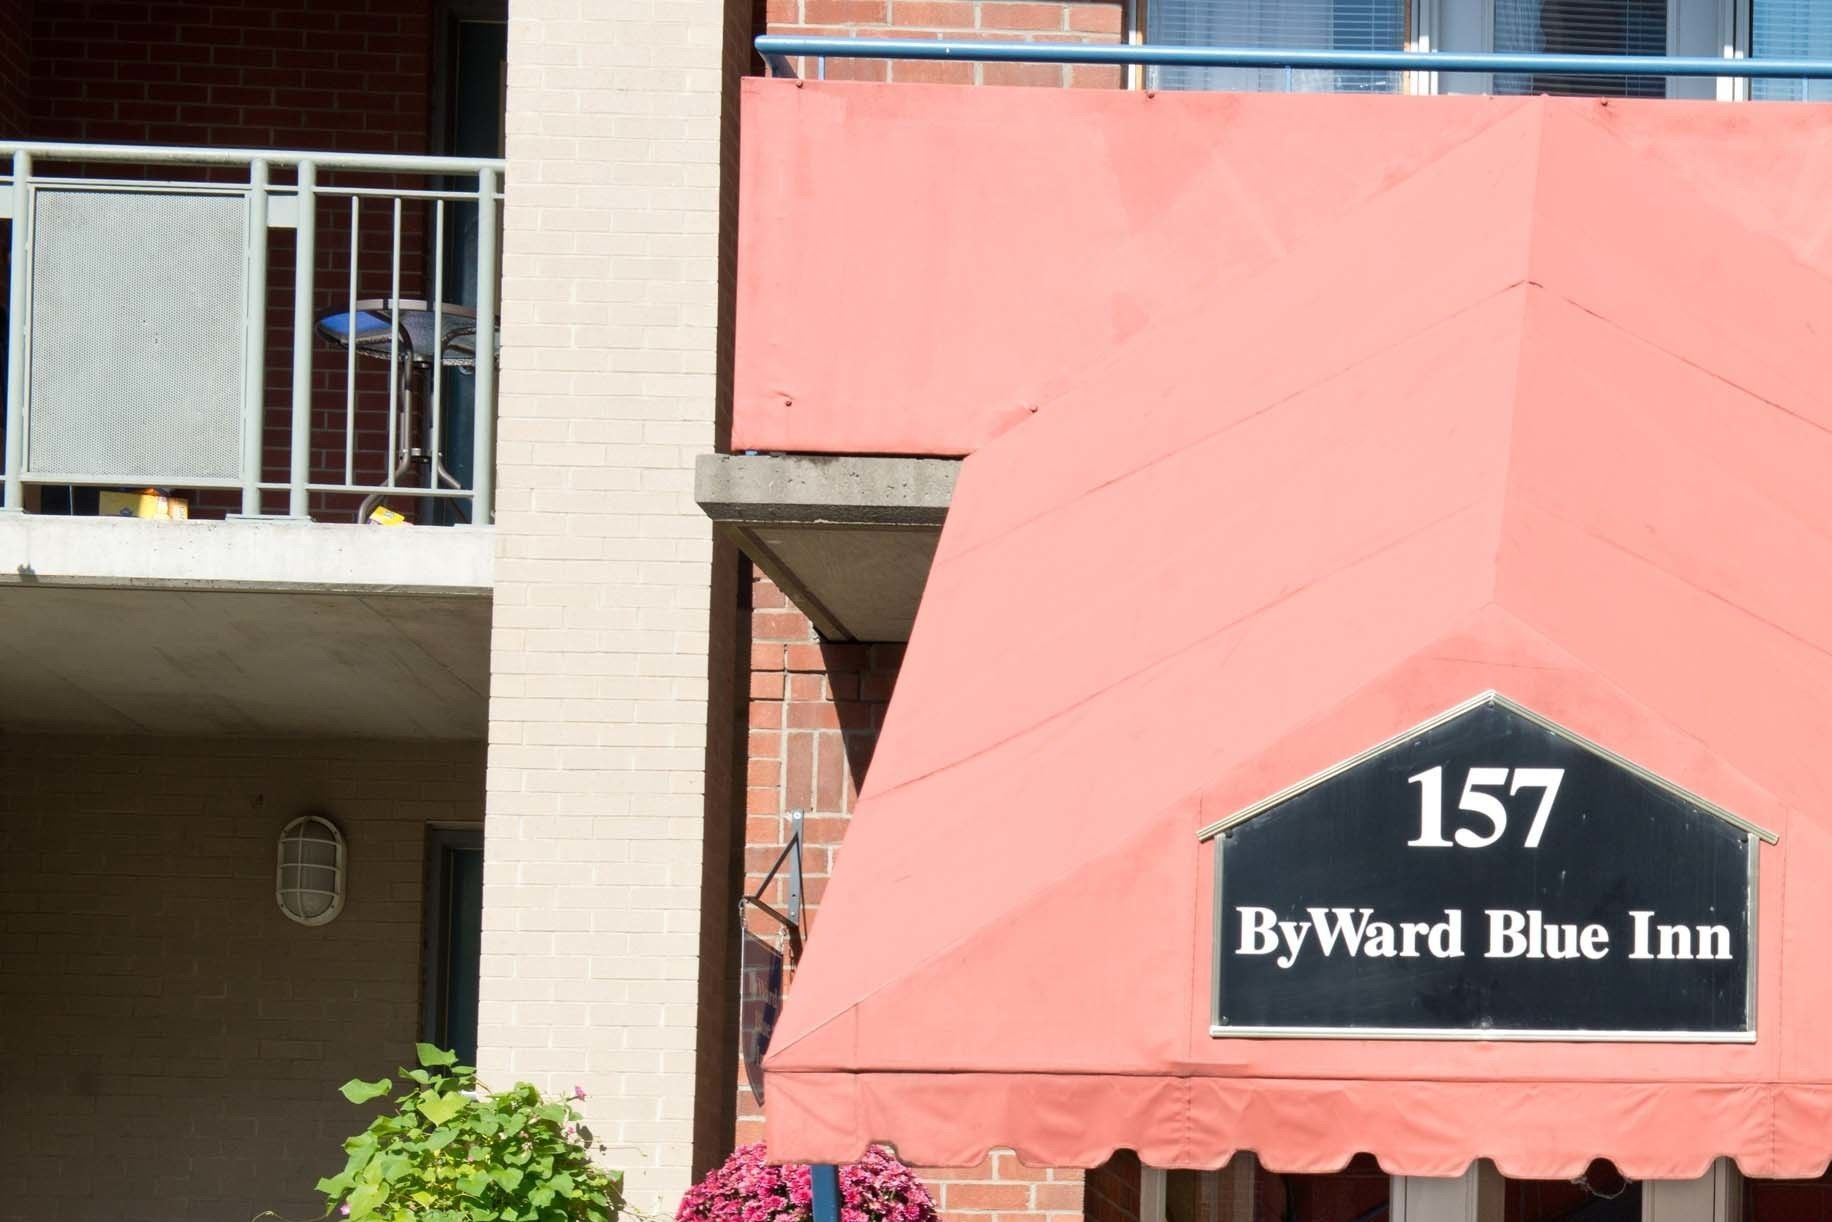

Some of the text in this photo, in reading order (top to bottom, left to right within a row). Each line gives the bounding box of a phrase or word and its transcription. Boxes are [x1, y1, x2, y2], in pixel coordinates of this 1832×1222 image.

[1407, 765, 1565, 849] 157
[1235, 906, 1733, 969] ByWard Blue Inn
